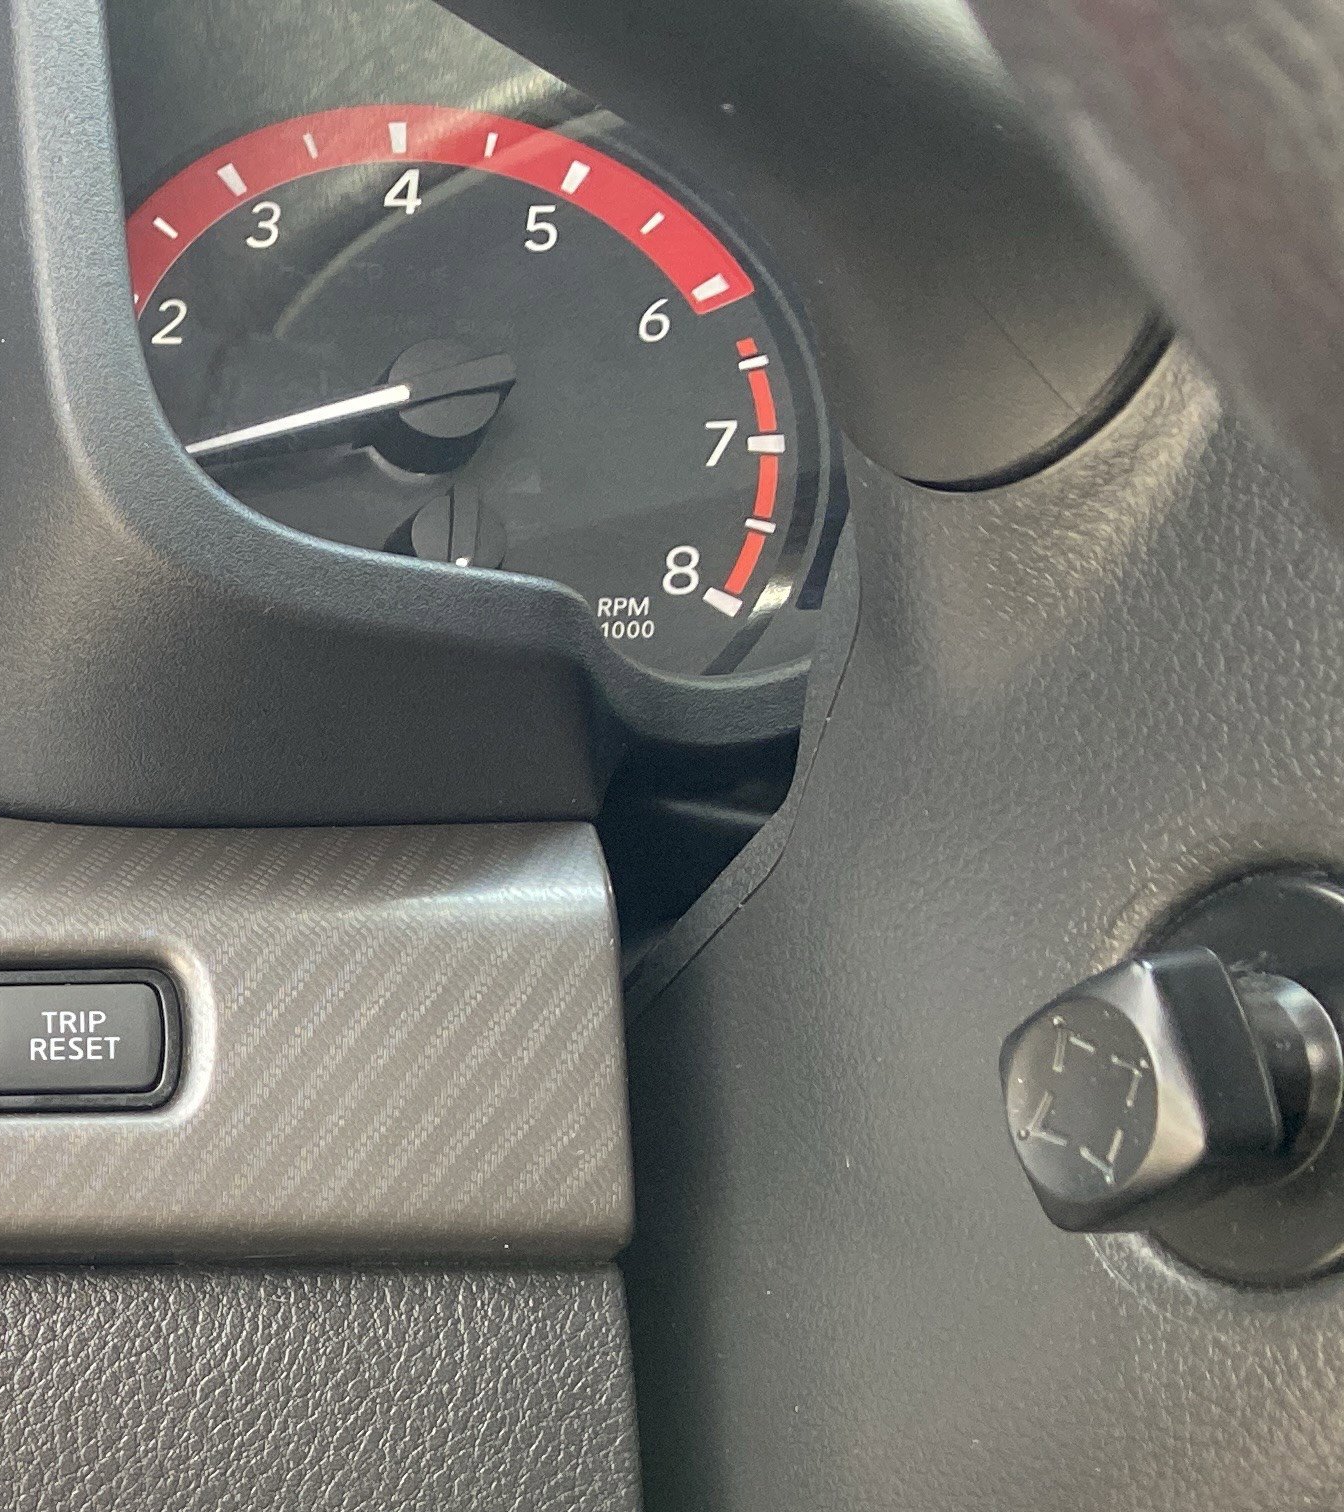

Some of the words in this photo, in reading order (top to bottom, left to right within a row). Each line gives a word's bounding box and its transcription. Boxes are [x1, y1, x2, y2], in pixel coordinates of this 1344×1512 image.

[383, 168, 423, 215] 4
[241, 201, 281, 249] 3
[524, 204, 558, 252] 5
[151, 300, 187, 345] 2
[638, 298, 670, 342] 6
[705, 420, 738, 467] 7
[662, 545, 701, 596] 8
[597, 596, 650, 618] RPM
[601, 619, 655, 639] 1000
[41, 1010, 107, 1034] TRIP
[30, 1036, 121, 1061] RESET
